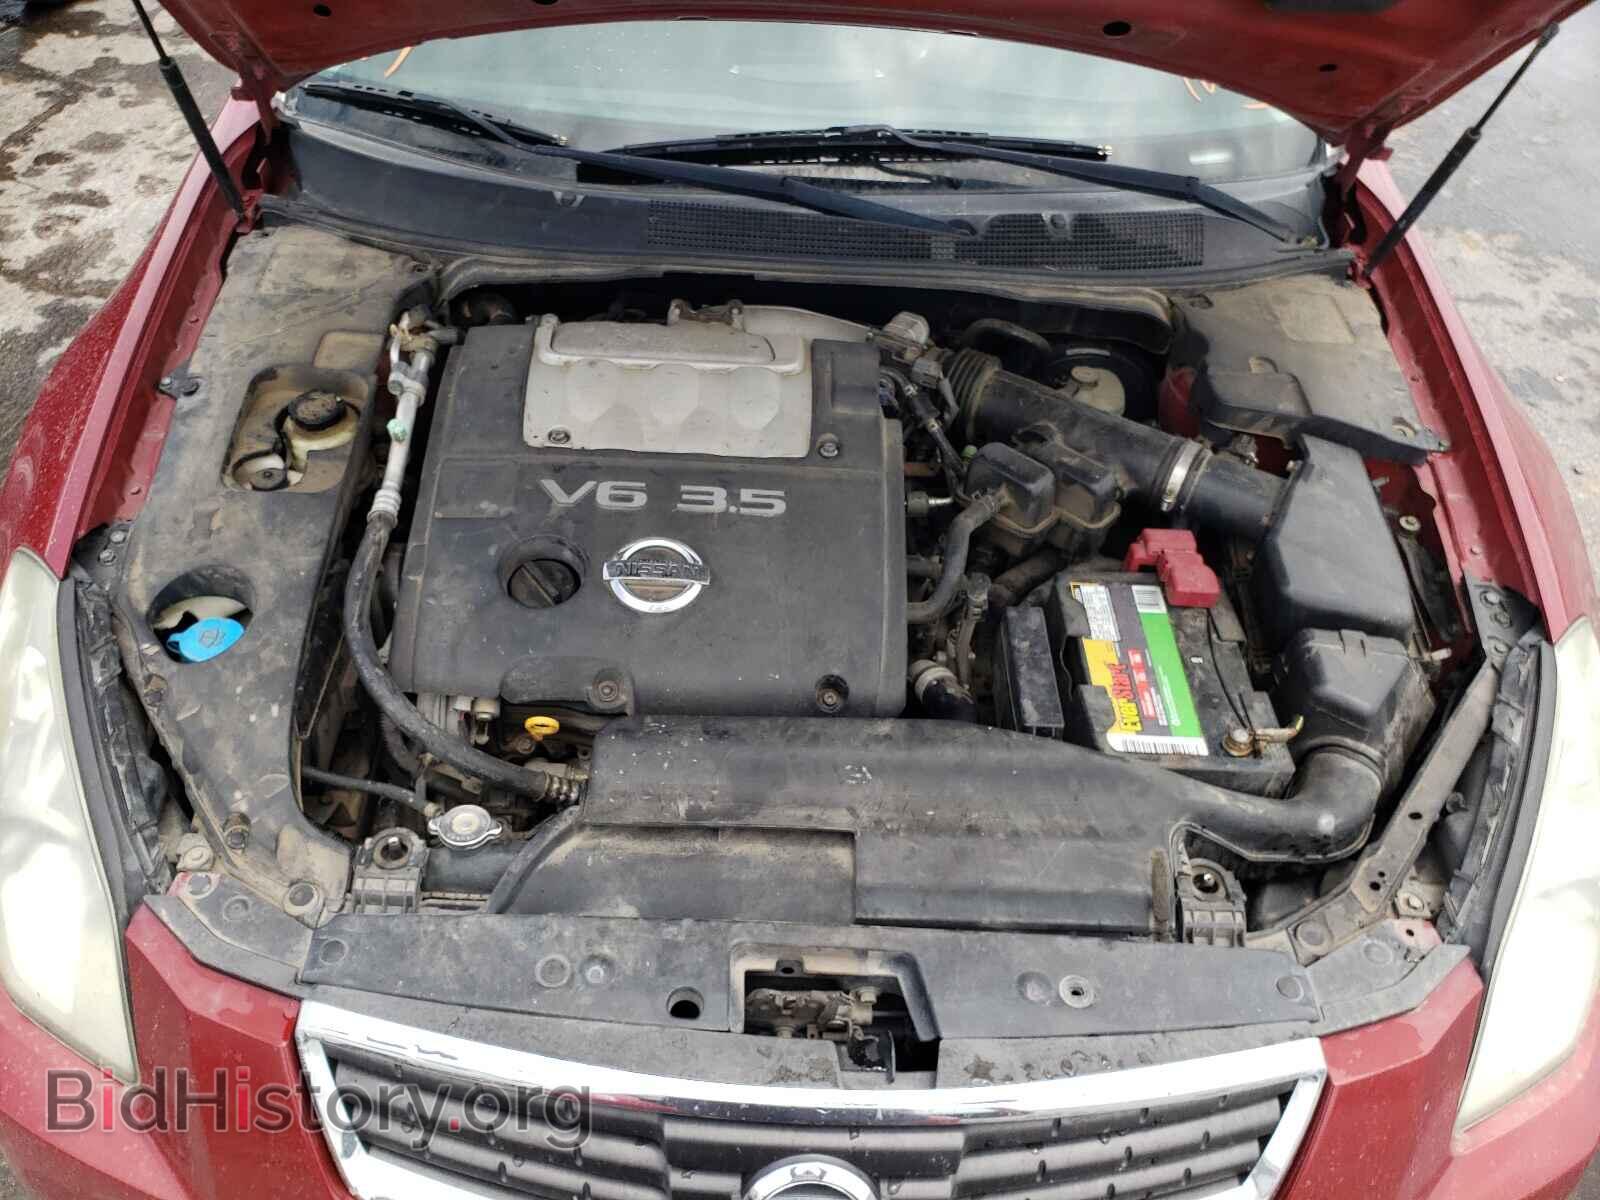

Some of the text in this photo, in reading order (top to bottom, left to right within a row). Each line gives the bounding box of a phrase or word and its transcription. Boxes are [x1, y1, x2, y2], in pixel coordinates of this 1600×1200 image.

[540, 479, 787, 517] V6 3.5
[615, 561, 703, 580] NISSAN
